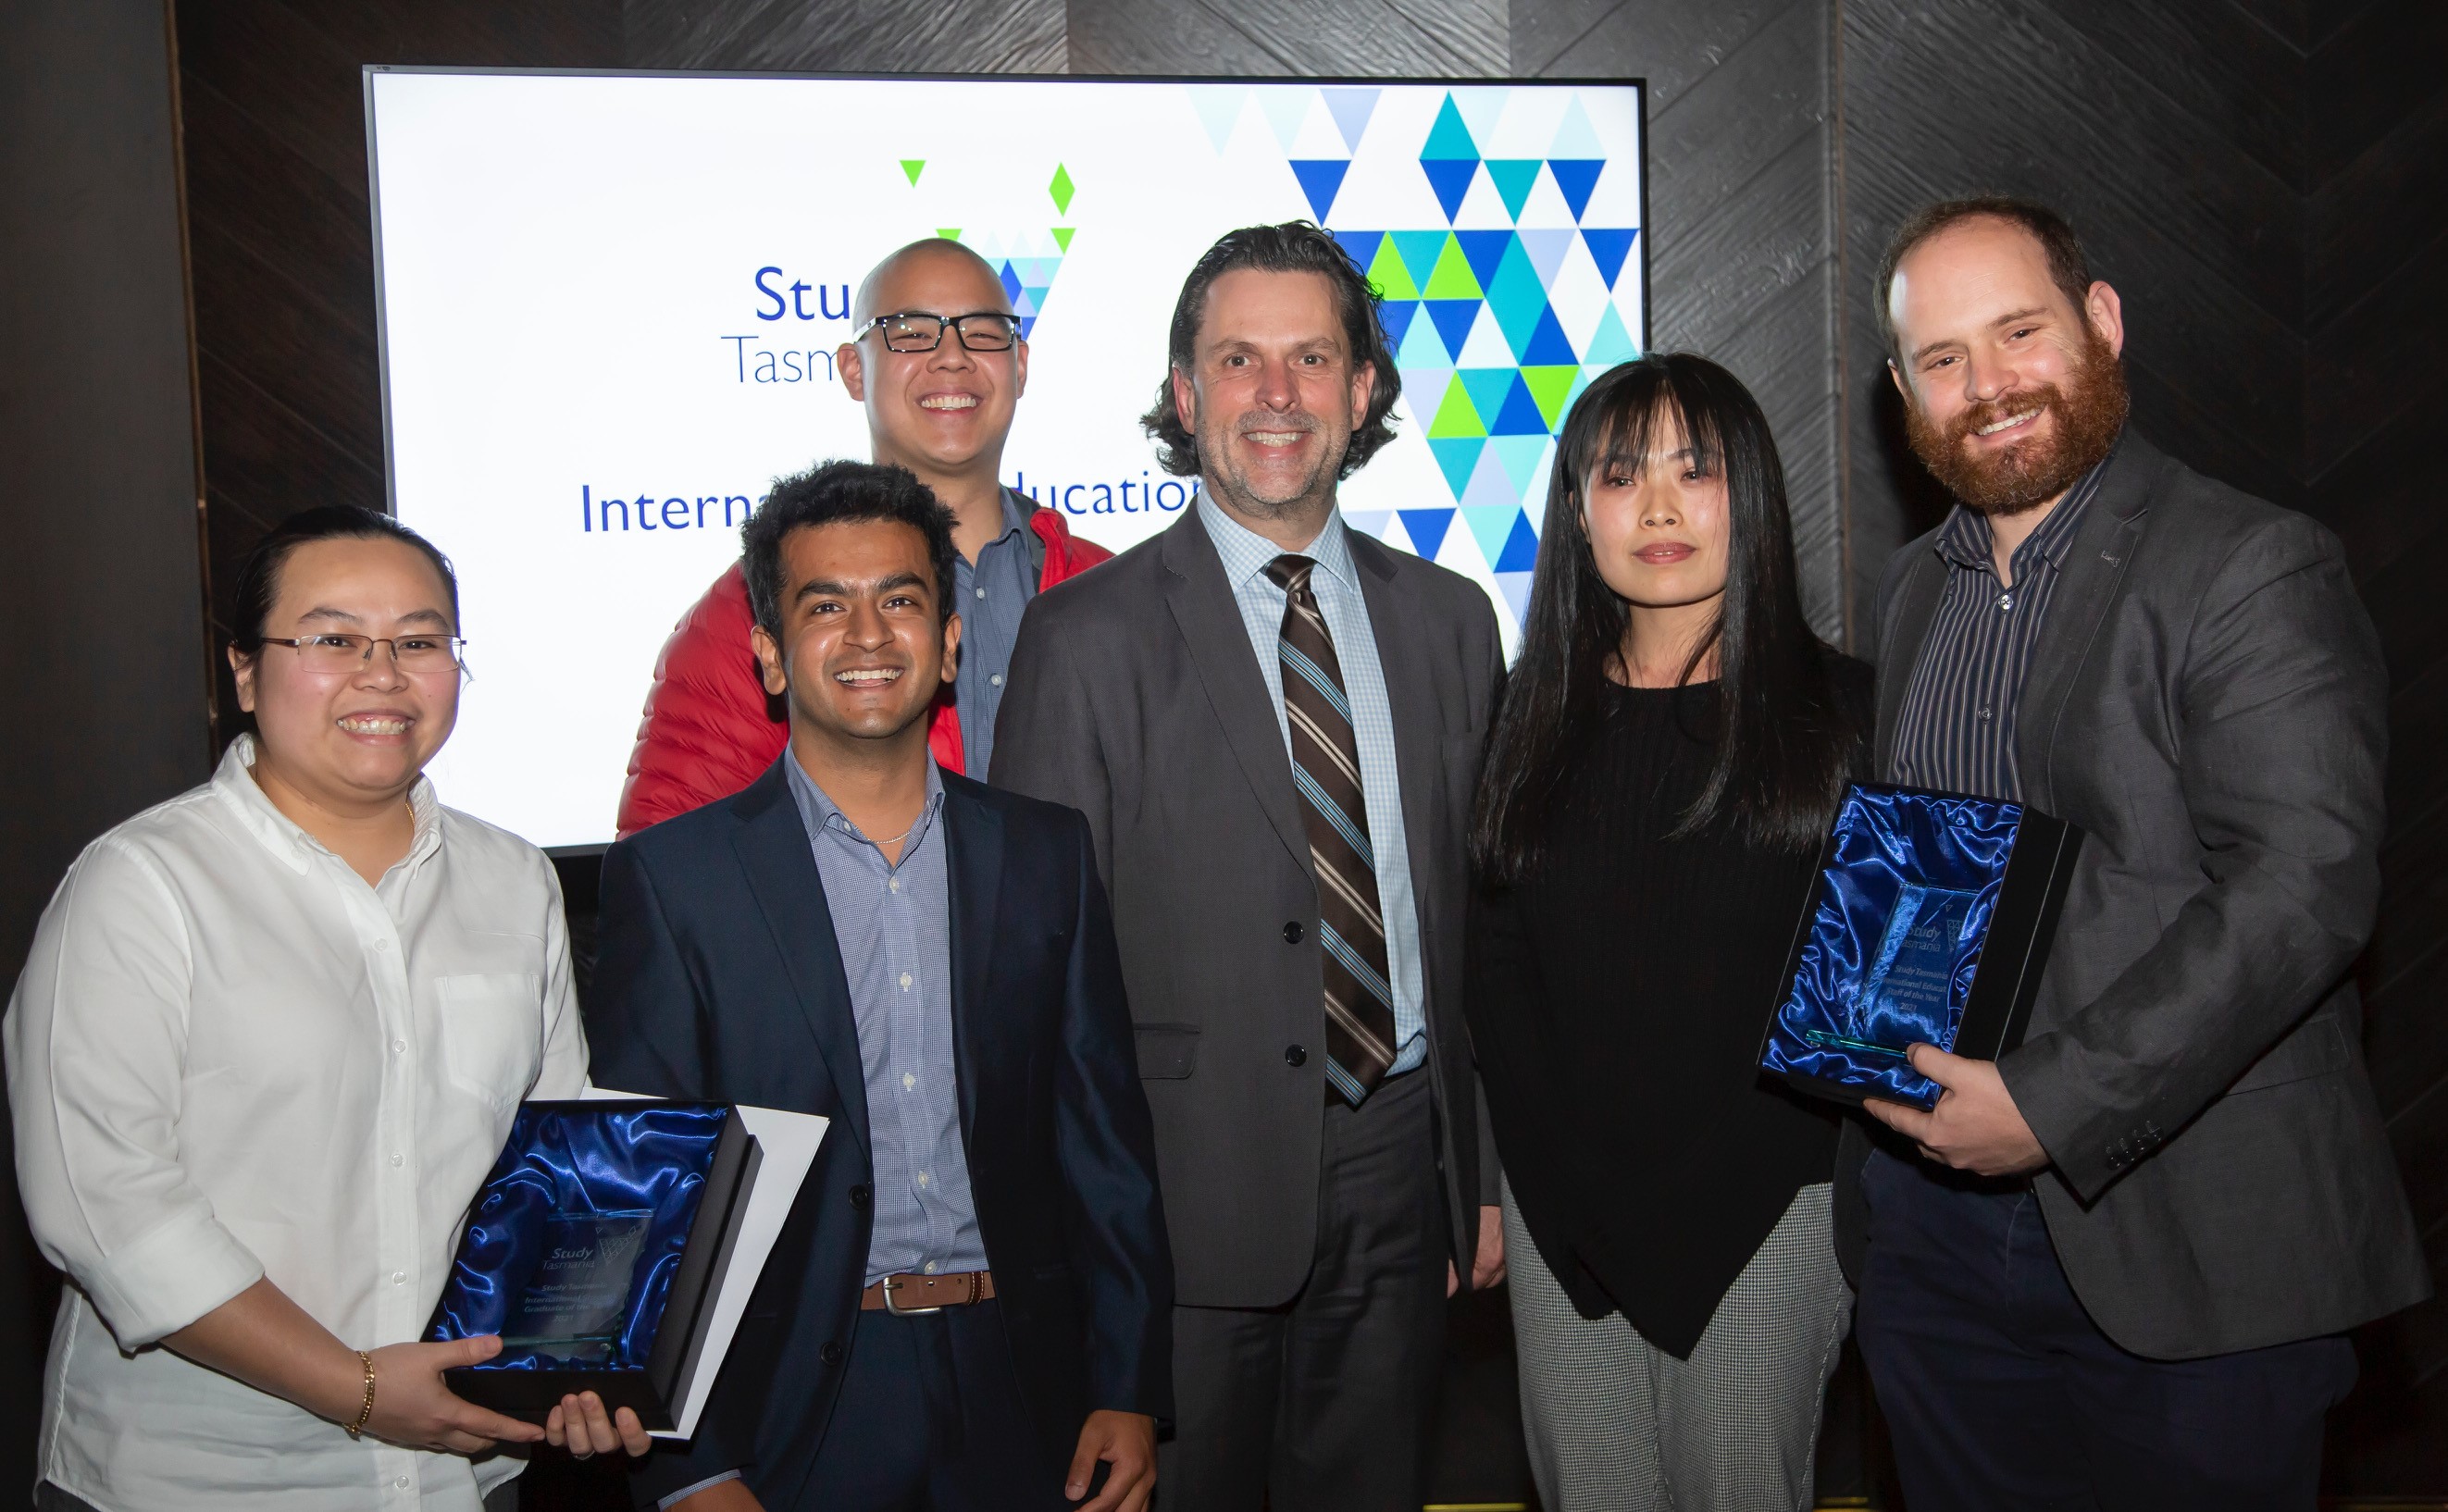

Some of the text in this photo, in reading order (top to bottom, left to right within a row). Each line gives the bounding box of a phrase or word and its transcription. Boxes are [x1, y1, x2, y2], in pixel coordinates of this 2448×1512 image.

[582, 485, 770, 532] Intern
[552, 1246, 593, 1260] Study
[543, 1259, 595, 1270] Tasmania
